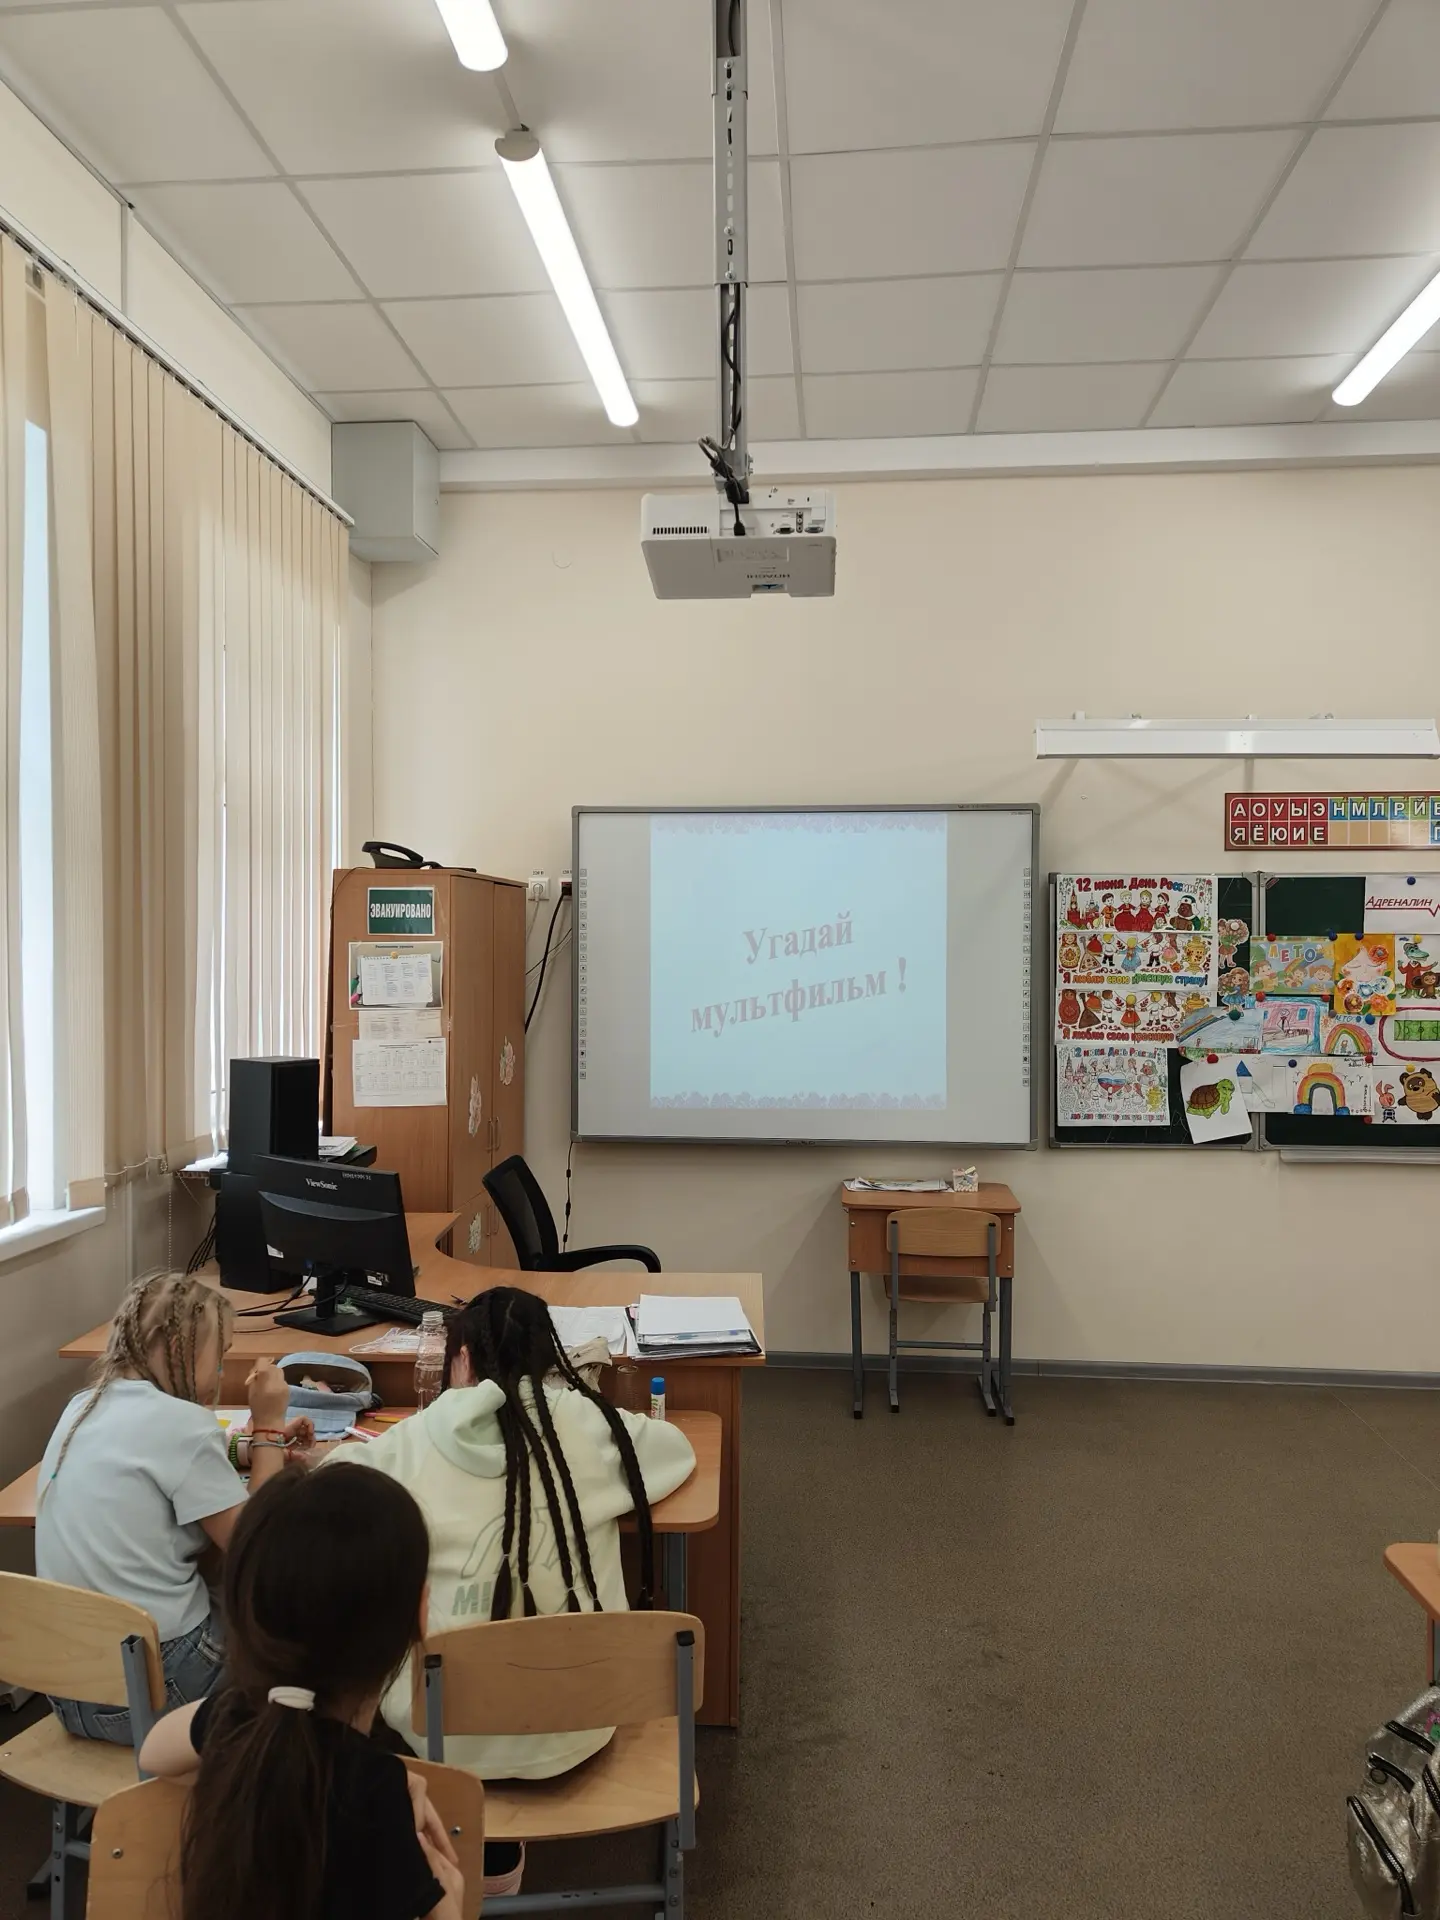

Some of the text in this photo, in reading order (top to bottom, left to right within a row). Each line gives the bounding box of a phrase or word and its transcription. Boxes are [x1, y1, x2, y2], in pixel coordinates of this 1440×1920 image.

[1076, 877, 1091, 892] 12
[1094, 879, 1127, 890] июня.
[1129, 877, 1157, 890] День
[370, 903, 431, 918] ЭВАКУИРОВАНО
[743, 911, 854, 965] Угадай
[1063, 972, 1208, 987] Я люблю свою красивую страну!
[691, 971, 887, 1038] мультфильм
[1063, 1028, 1071, 1041] Я
[1072, 1028, 1105, 1041] люблю
[1106, 1031, 1130, 1041] свою
[1131, 1032, 1174, 1043] красивую
[305, 1177, 338, 1191] ViewSonic
